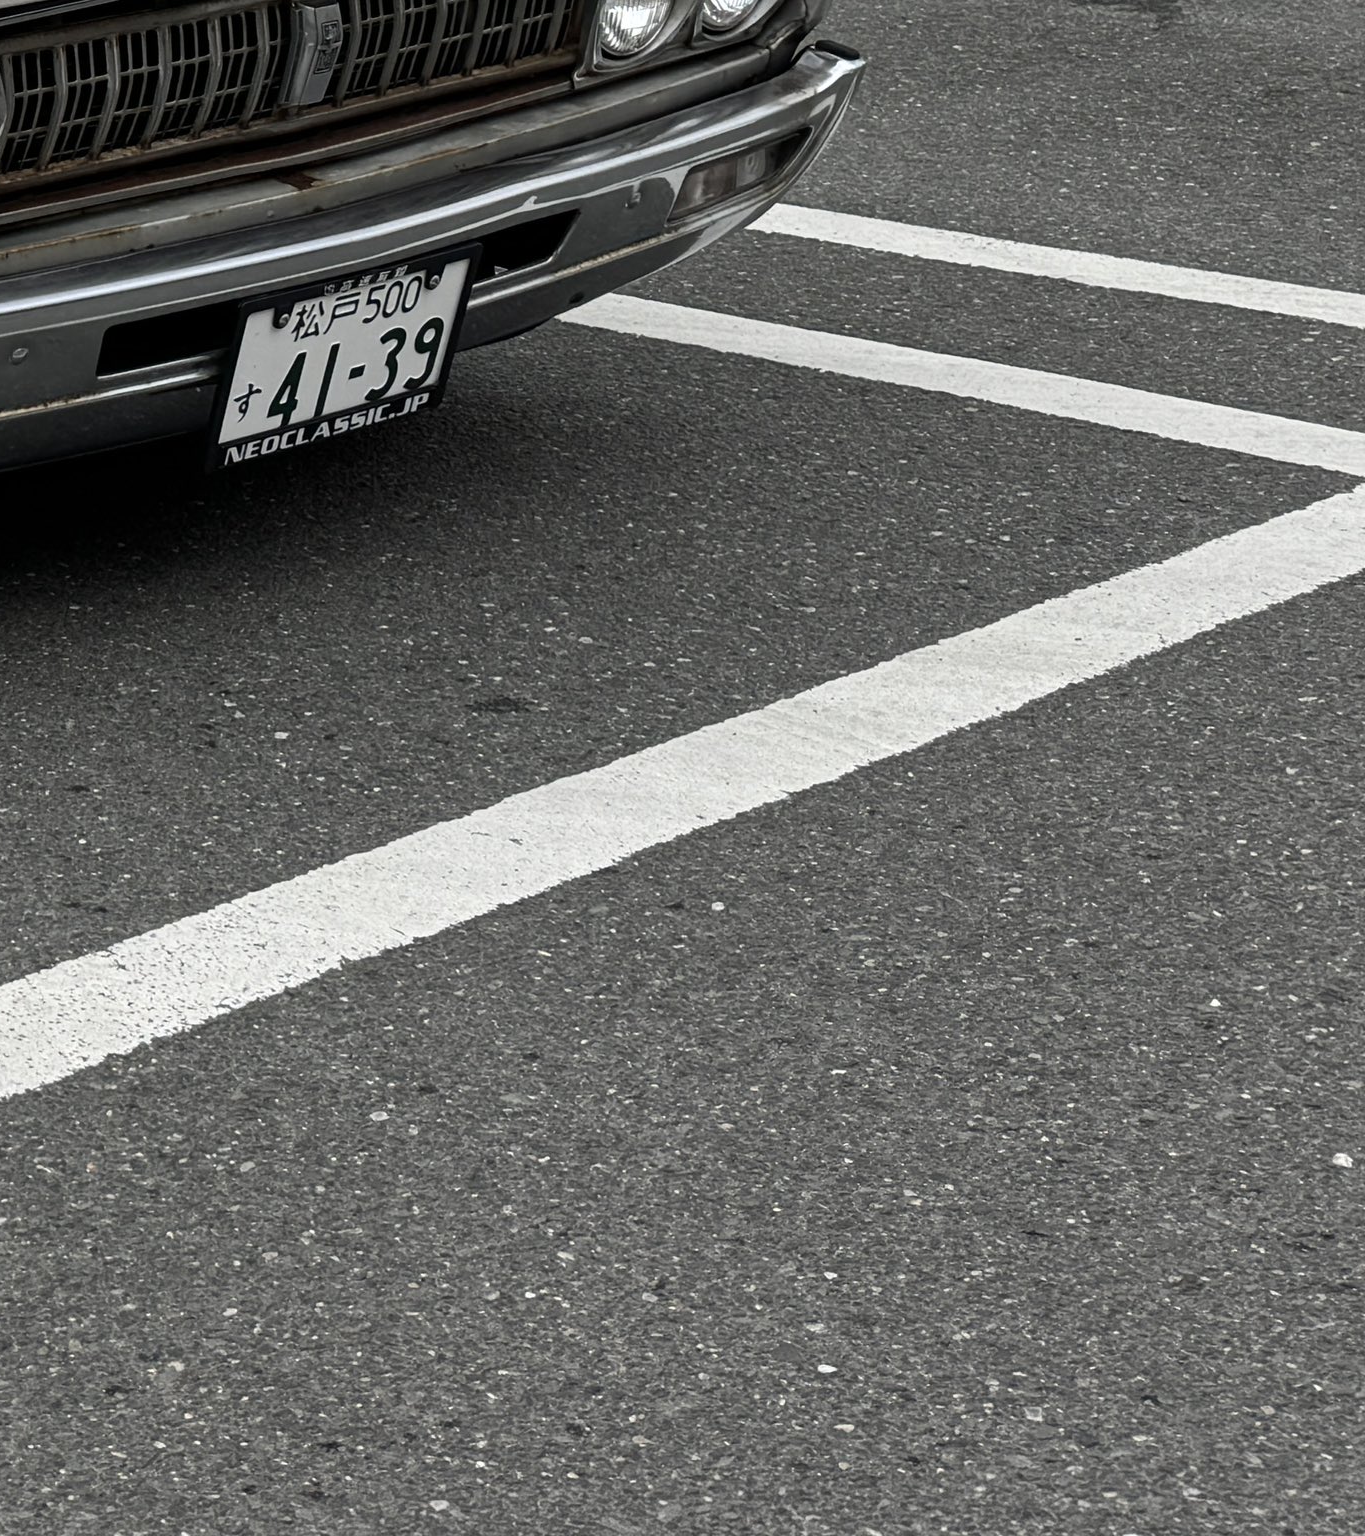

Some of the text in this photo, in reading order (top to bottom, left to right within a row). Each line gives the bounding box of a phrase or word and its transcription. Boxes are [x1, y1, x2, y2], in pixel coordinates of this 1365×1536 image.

[233, 317, 444, 426] す 41-39
[224, 393, 430, 466] NEOCLASSIC.JP
